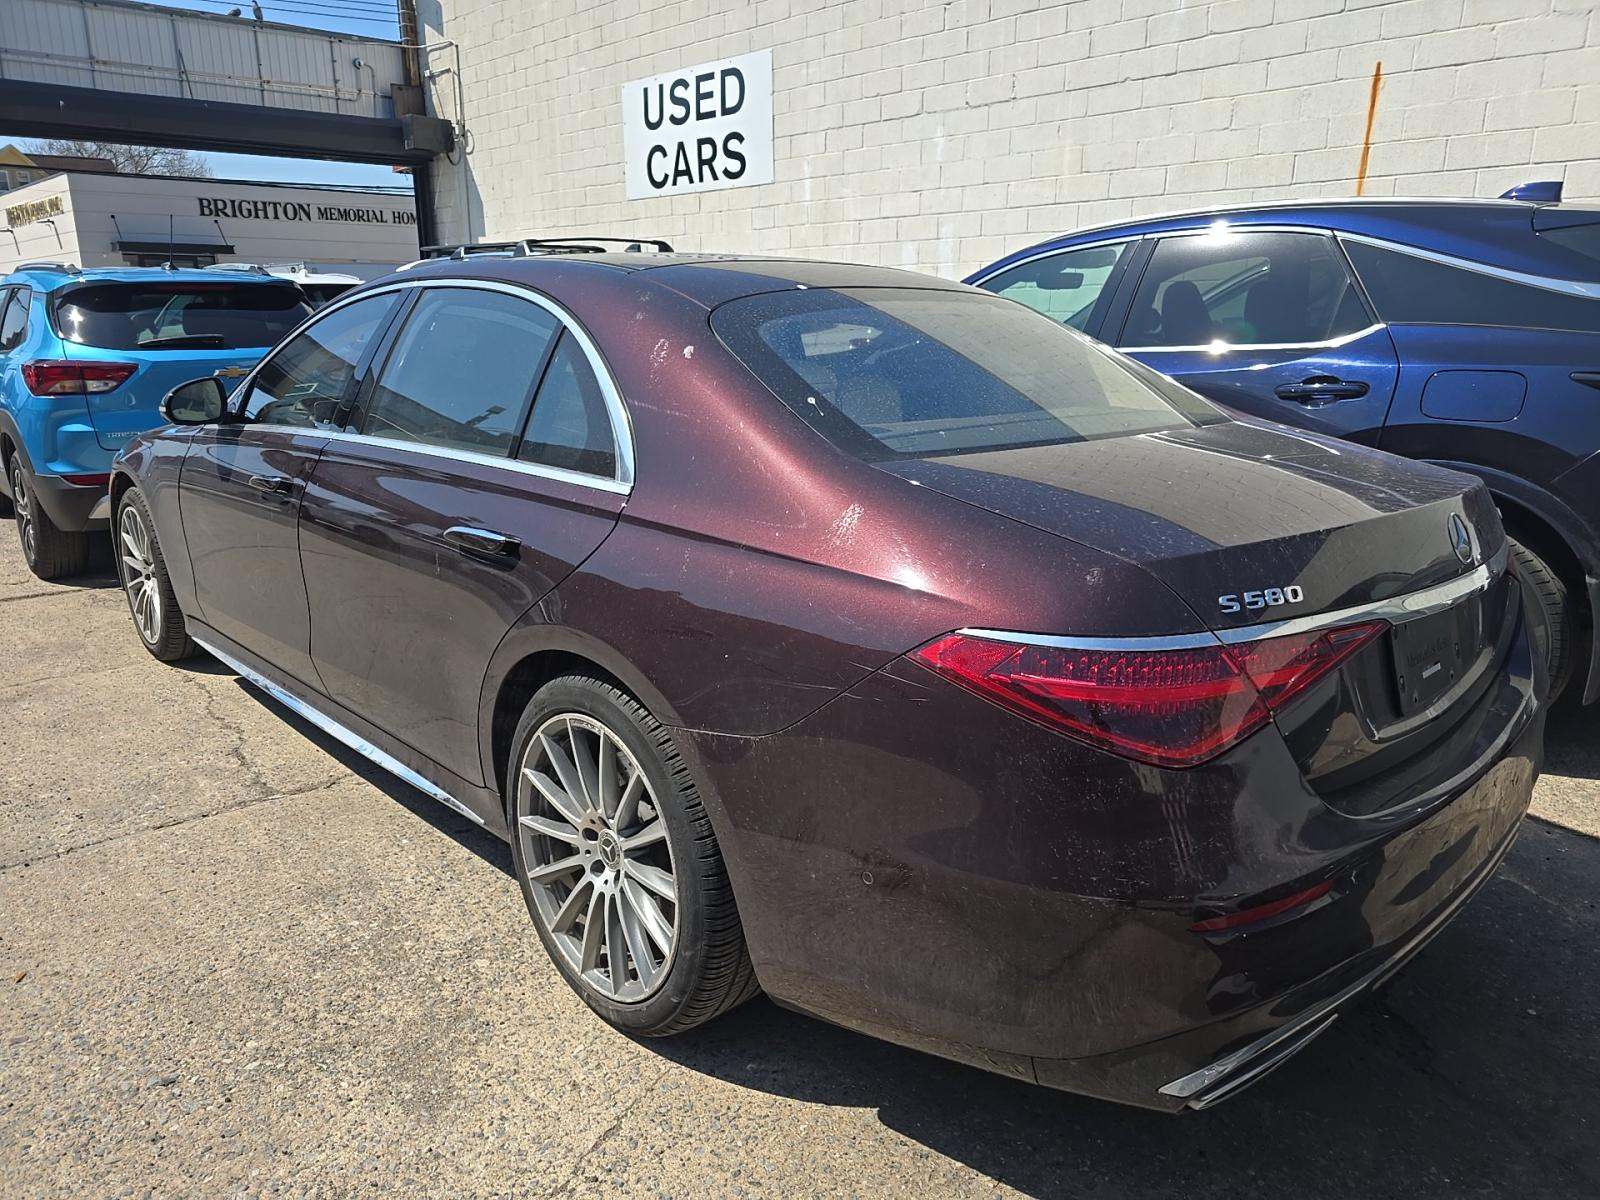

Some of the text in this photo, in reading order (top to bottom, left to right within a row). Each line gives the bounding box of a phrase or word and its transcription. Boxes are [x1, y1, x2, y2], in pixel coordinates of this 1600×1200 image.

[643, 67, 746, 130] USED
[646, 131, 747, 189] CARS
[198, 198, 312, 221] BRIGHTON
[317, 206, 388, 224] MEMORIAL
[1218, 585, 1304, 613] S 580
